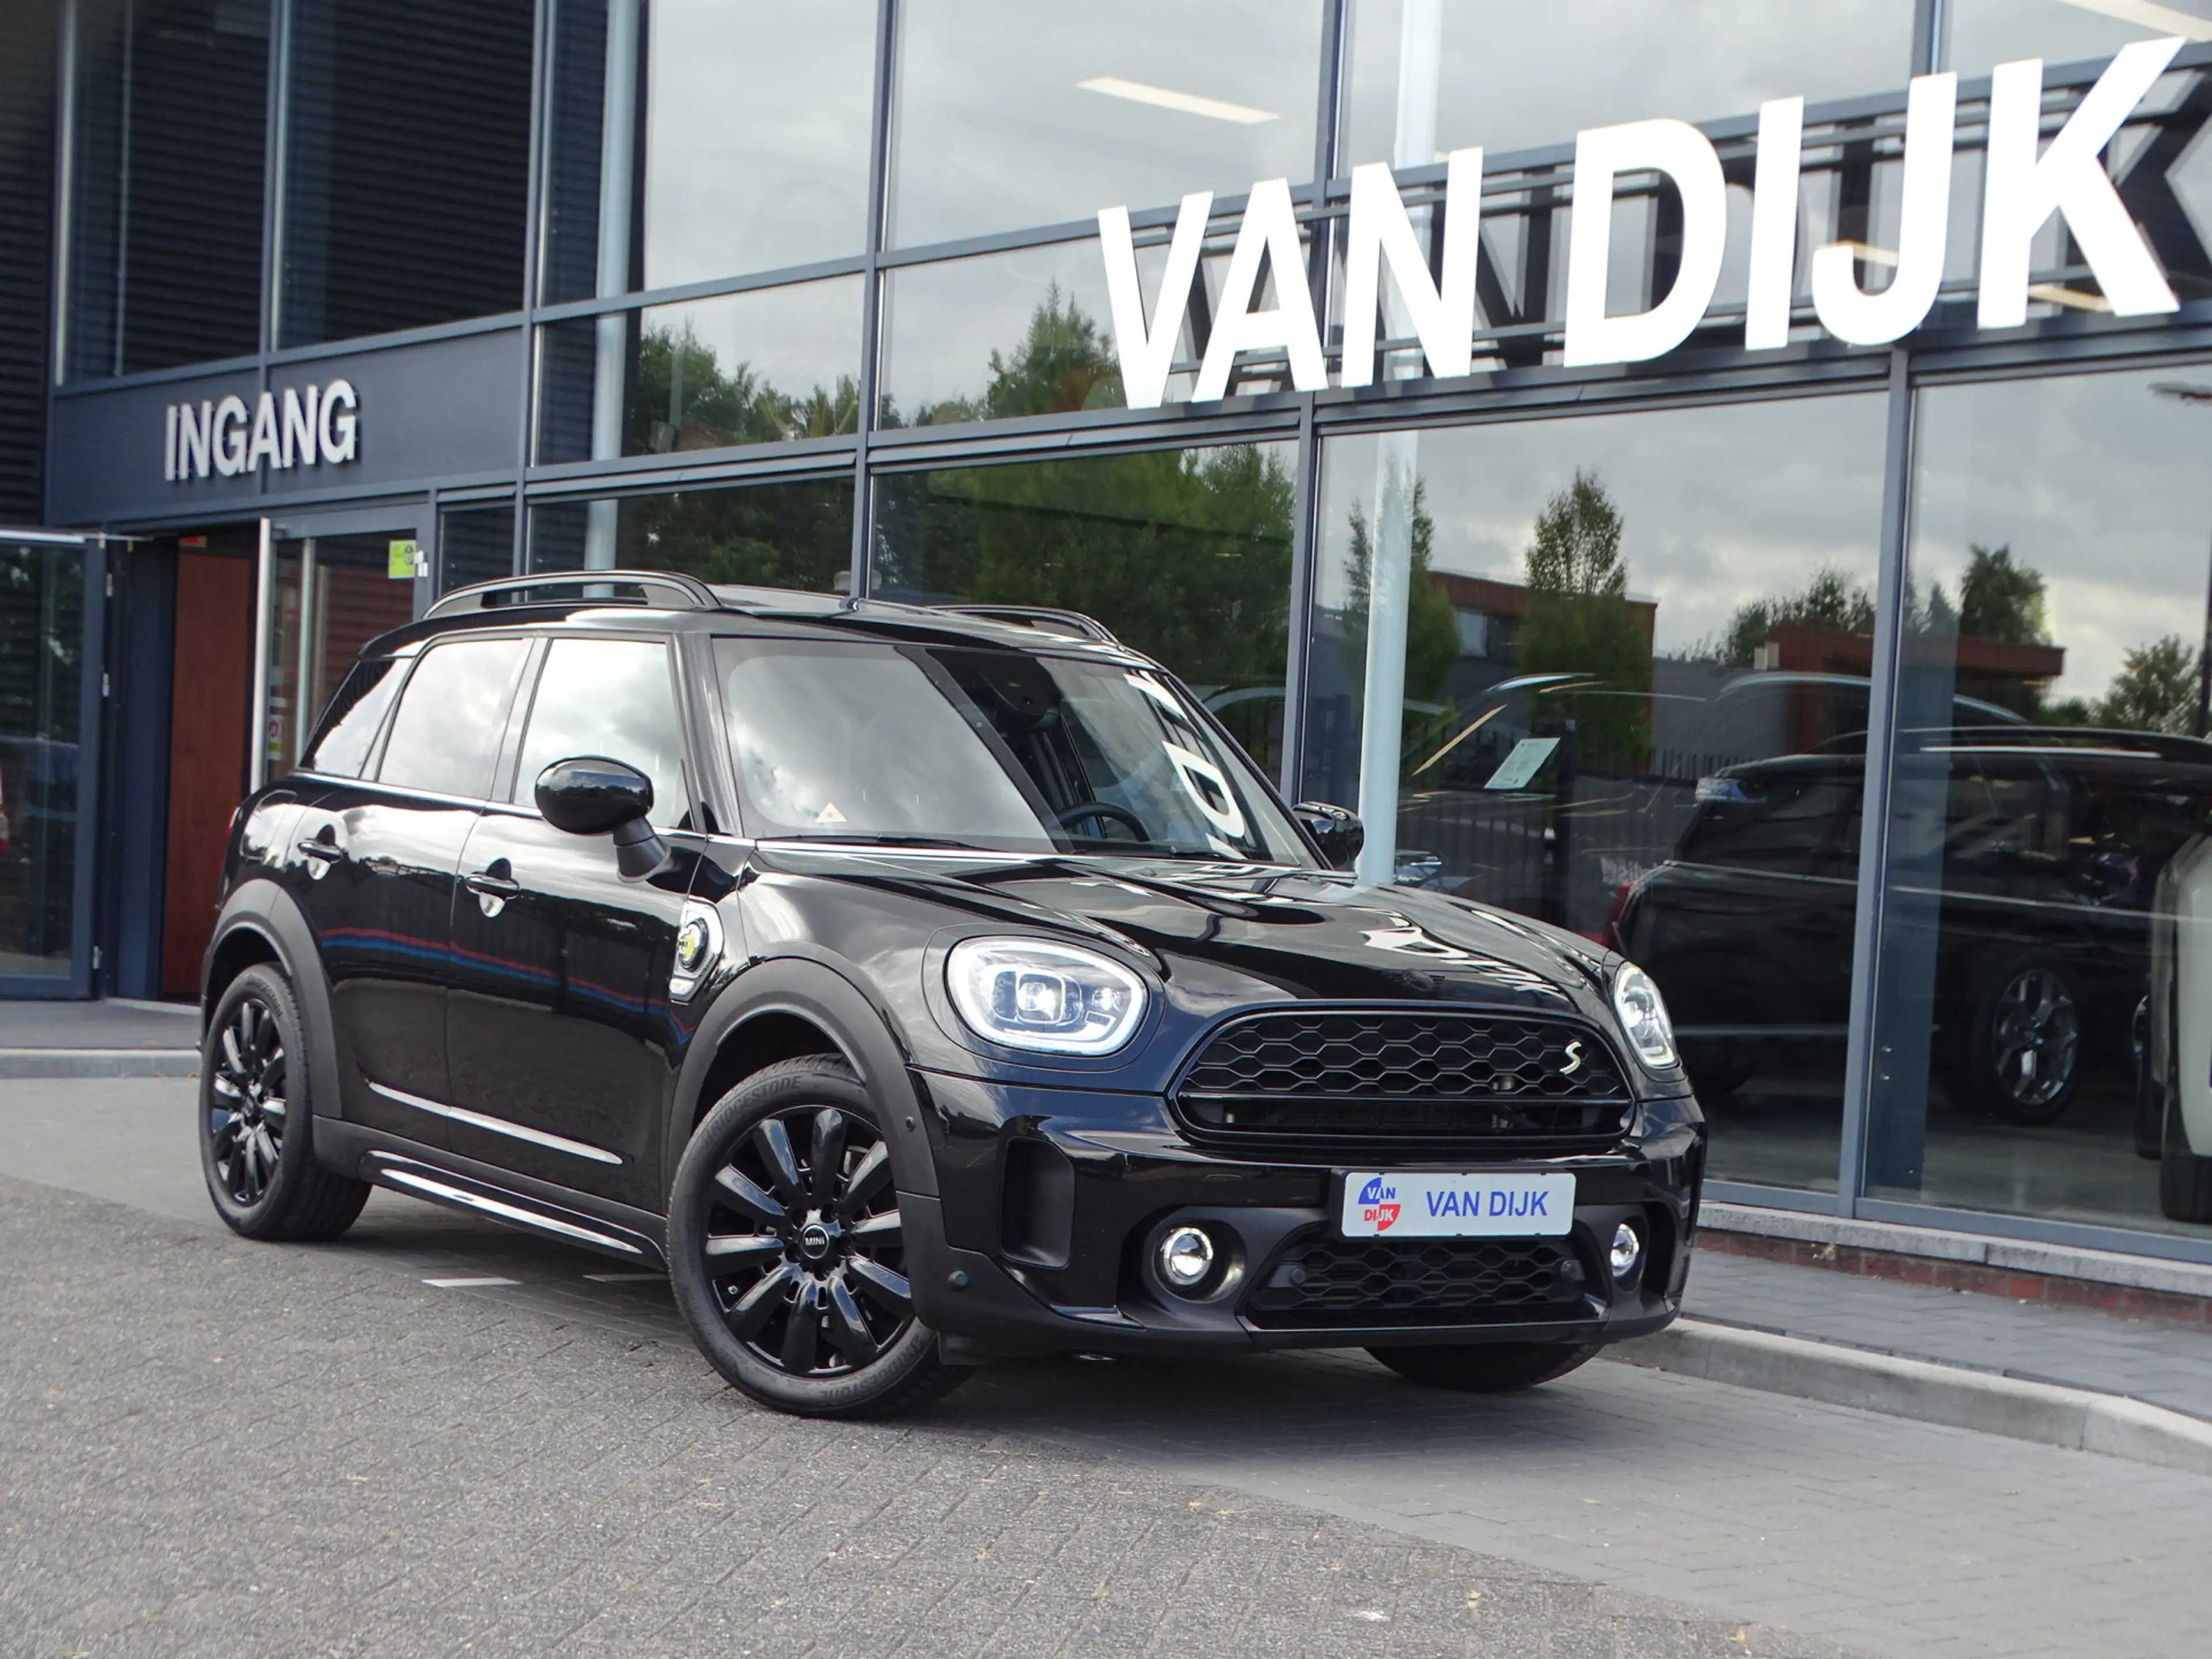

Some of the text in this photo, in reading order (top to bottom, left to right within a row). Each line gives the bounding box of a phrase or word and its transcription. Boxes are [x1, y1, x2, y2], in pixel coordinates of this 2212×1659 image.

[1098, 35, 2187, 410] VAN DIJK
[165, 378, 357, 481] INGANG
[1367, 1187, 1396, 1200] VAN
[1426, 1191, 1550, 1217] VAN DIJK
[1363, 1208, 1395, 1222] DIJK
[805, 1237, 825, 1246] MINI
